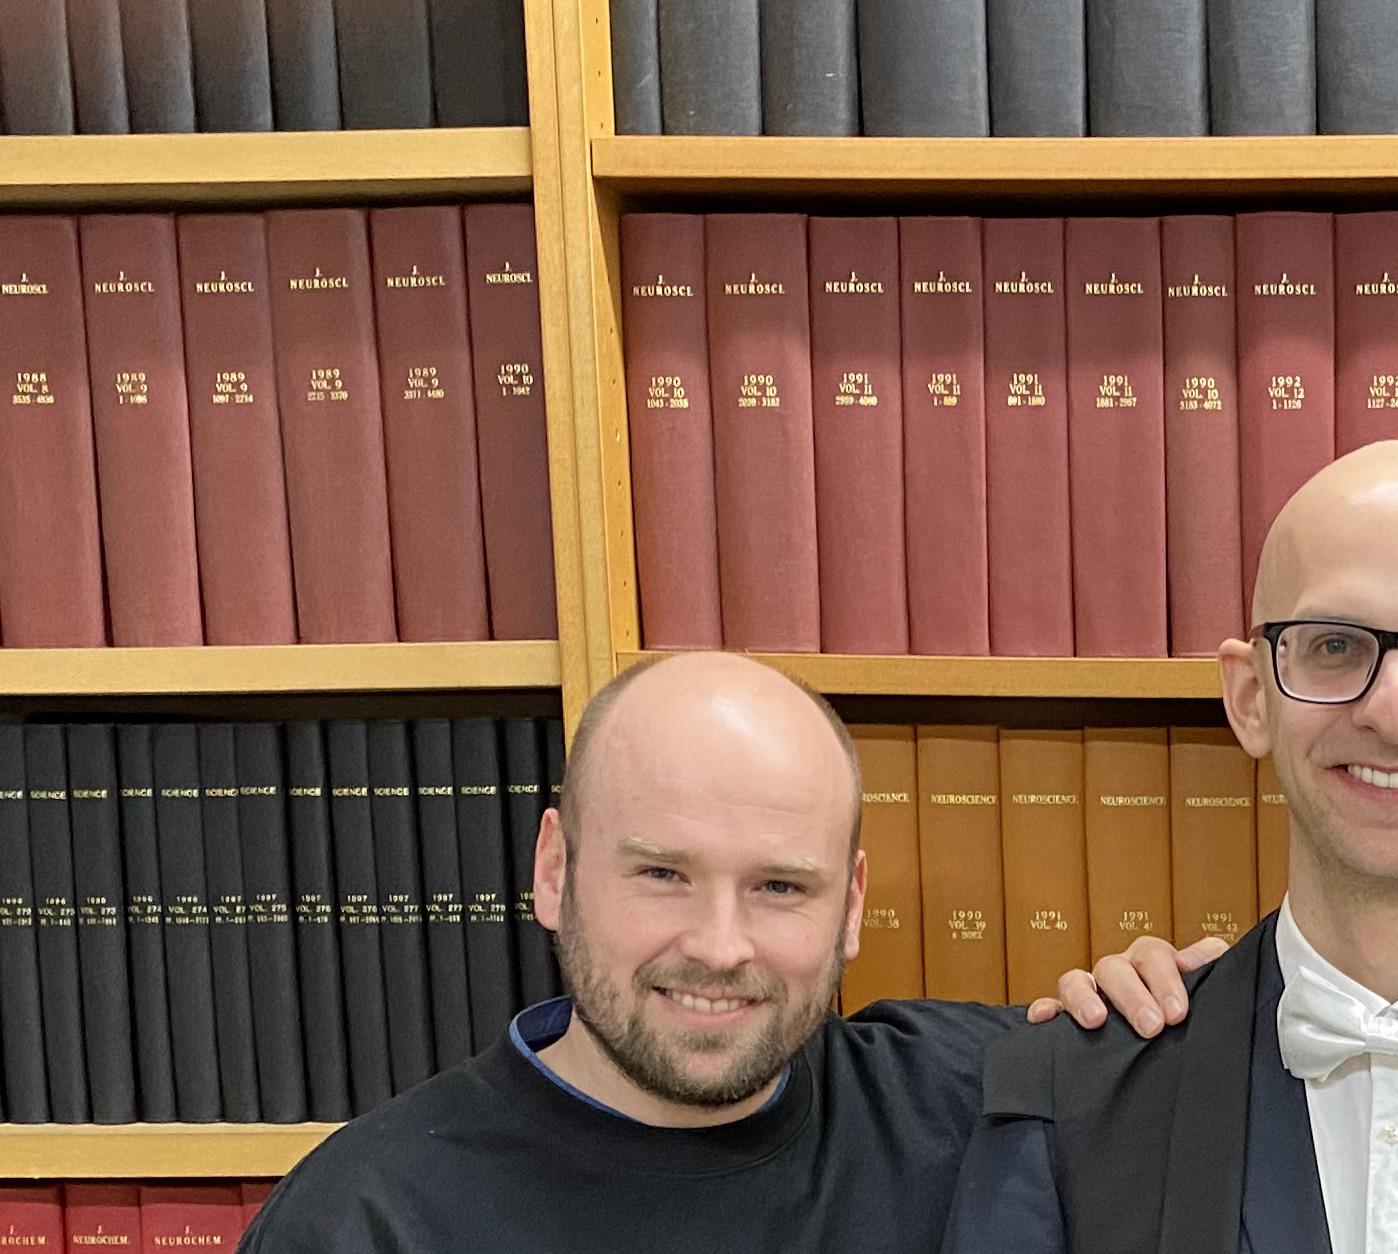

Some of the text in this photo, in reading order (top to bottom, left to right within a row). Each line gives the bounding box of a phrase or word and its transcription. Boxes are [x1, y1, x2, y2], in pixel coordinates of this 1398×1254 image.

[311, 369, 341, 380] 1989
[408, 368, 437, 379] 1989
[499, 364, 529, 375] 1990
[116, 373, 146, 383] 1989
[216, 373, 246, 383] 1989
[651, 377, 682, 388] 1990
[743, 375, 774, 386] 1990
[842, 373, 869, 384] 1991
[931, 374, 957, 385] 1991
[1012, 374, 1039, 385] 1991
[1102, 376, 1129, 386] 1991
[1271, 376, 1302, 387] 1992
[1184, 378, 1216, 389] 1990
[31, 791, 66, 799] SCIENCE
[74, 790, 107, 798] SCIENCE
[162, 789, 198, 797] SCIENCE
[333, 788, 367, 796] SCIENCE
[420, 787, 453, 795] SCIENCE
[462, 786, 496, 794] SCIENCE
[865, 909, 895, 918] 1990
[952, 911, 983, 921] 1990
[1034, 911, 1062, 921] 1991
[1122, 912, 1149, 921] 1991
[1205, 913, 1232, 923] 1991
